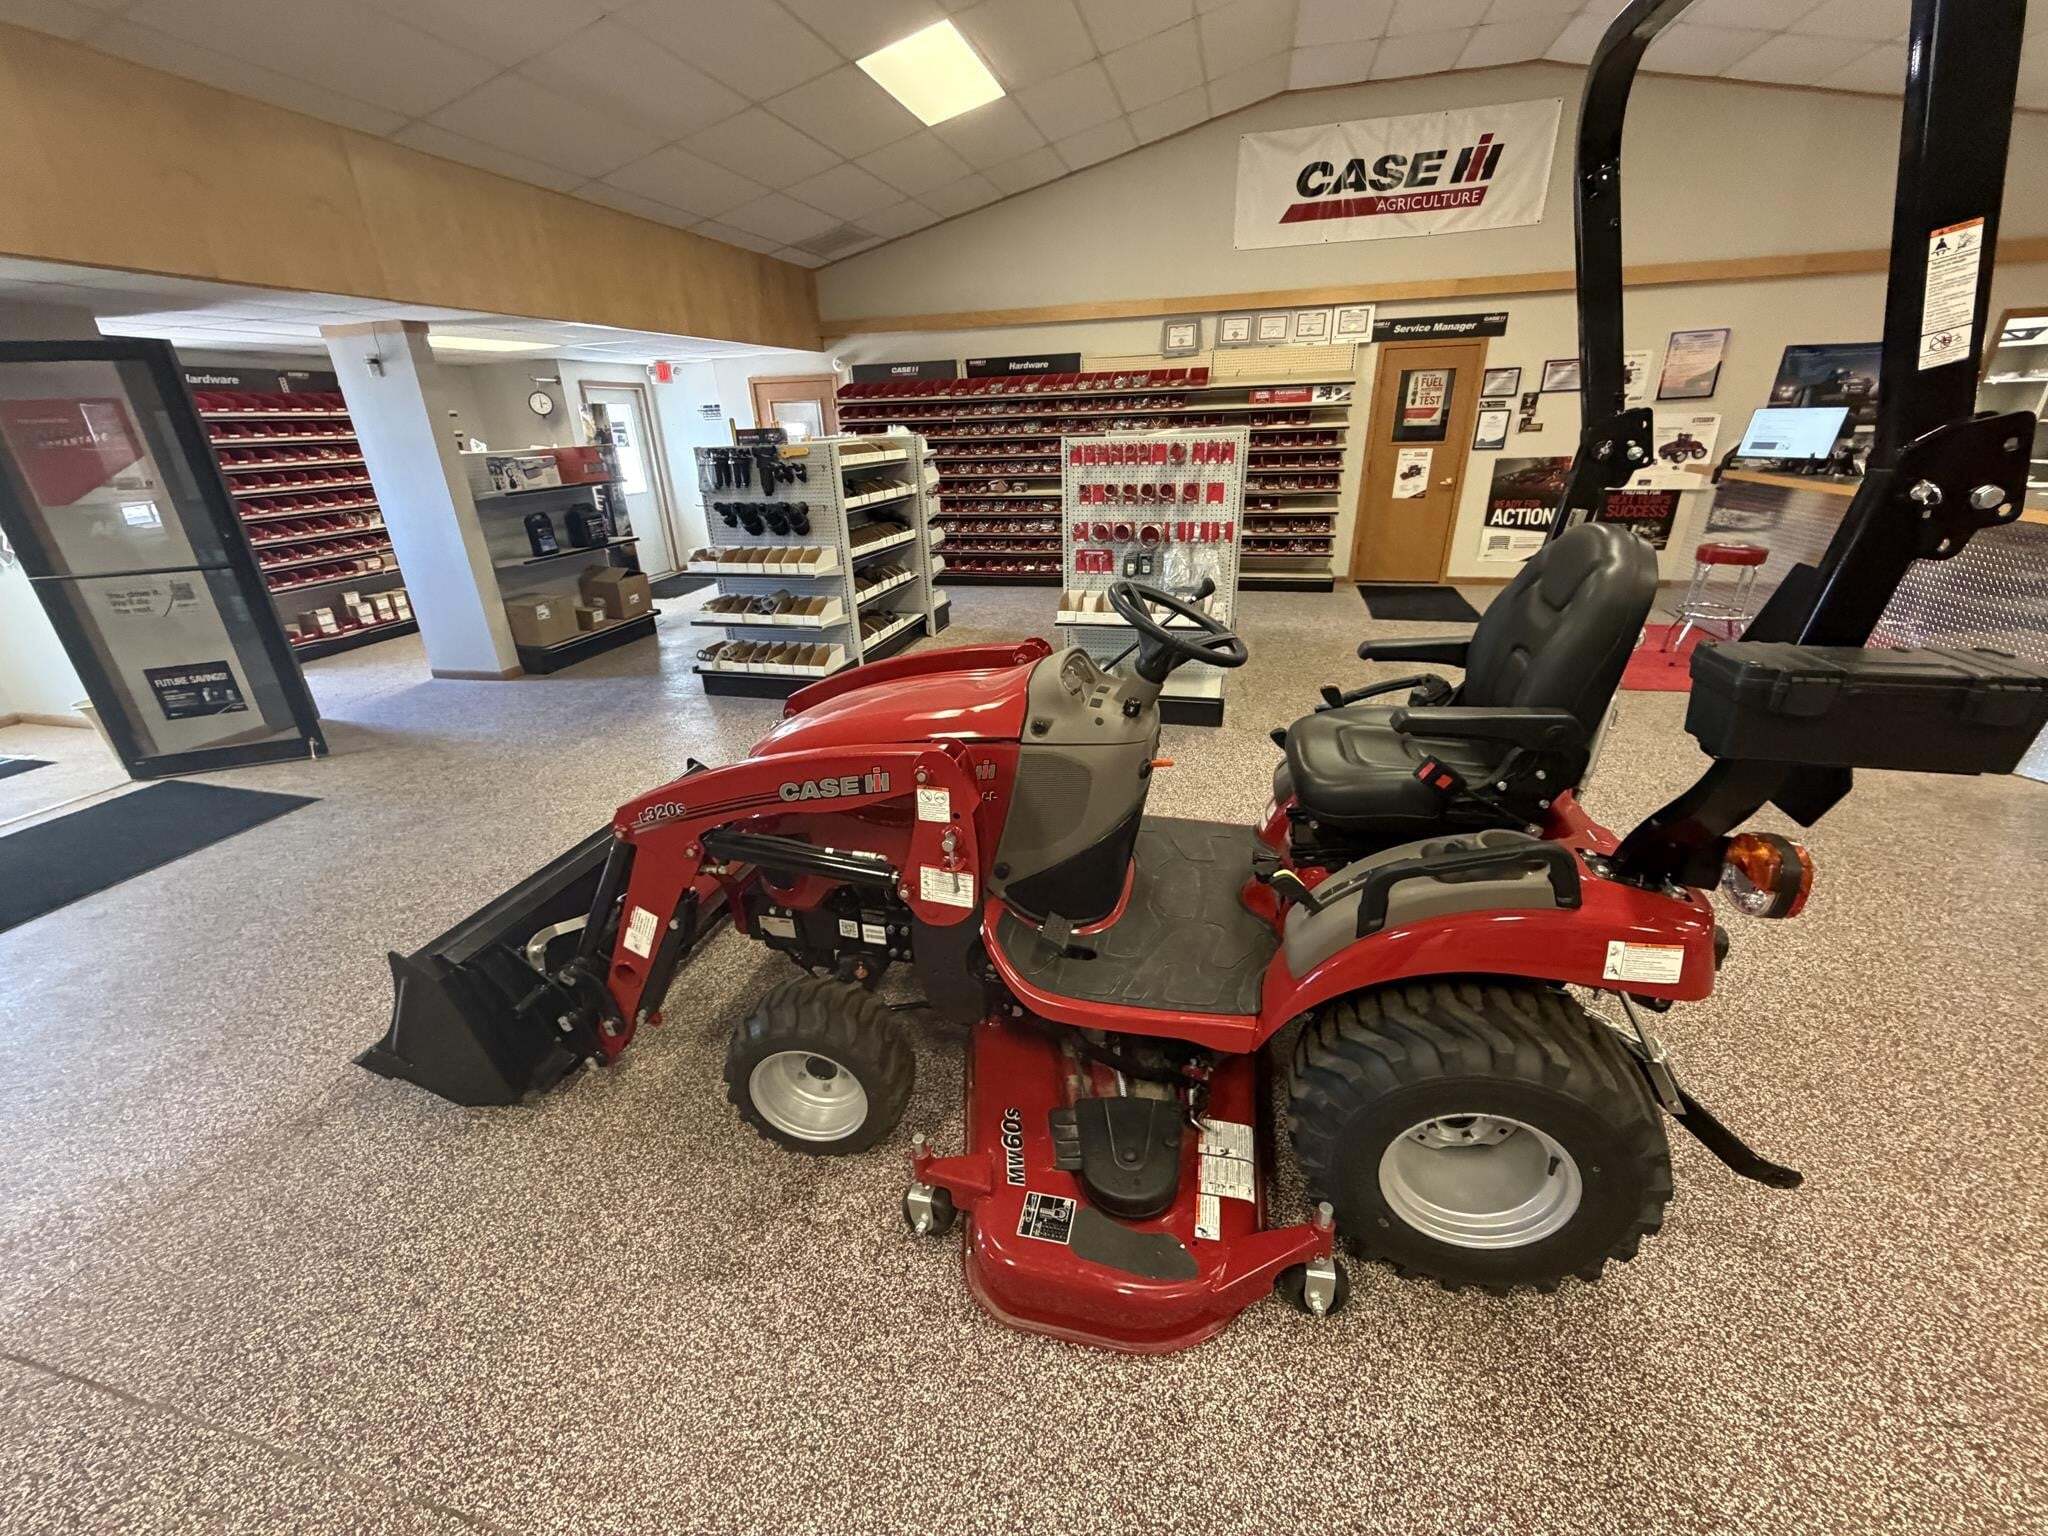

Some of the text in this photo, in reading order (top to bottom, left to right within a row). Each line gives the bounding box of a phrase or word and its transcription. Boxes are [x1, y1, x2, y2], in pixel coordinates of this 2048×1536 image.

[1296, 149, 1448, 198] CASE
[1376, 189, 1480, 212] AGRICULTURE
[1393, 320, 1478, 334] Service Manager
[890, 366, 913, 374] CASE
[1008, 361, 1049, 371] Hardware
[1421, 377, 1444, 387] FUEL
[1419, 396, 1441, 405] TEST
[1490, 507, 1557, 526] ACTION
[1605, 504, 1669, 518] SUCCESS
[154, 676, 189, 688] FUTURE
[778, 775, 860, 802] CASE
[638, 801, 686, 824] L320s
[1001, 1107, 1025, 1186] MW60s
